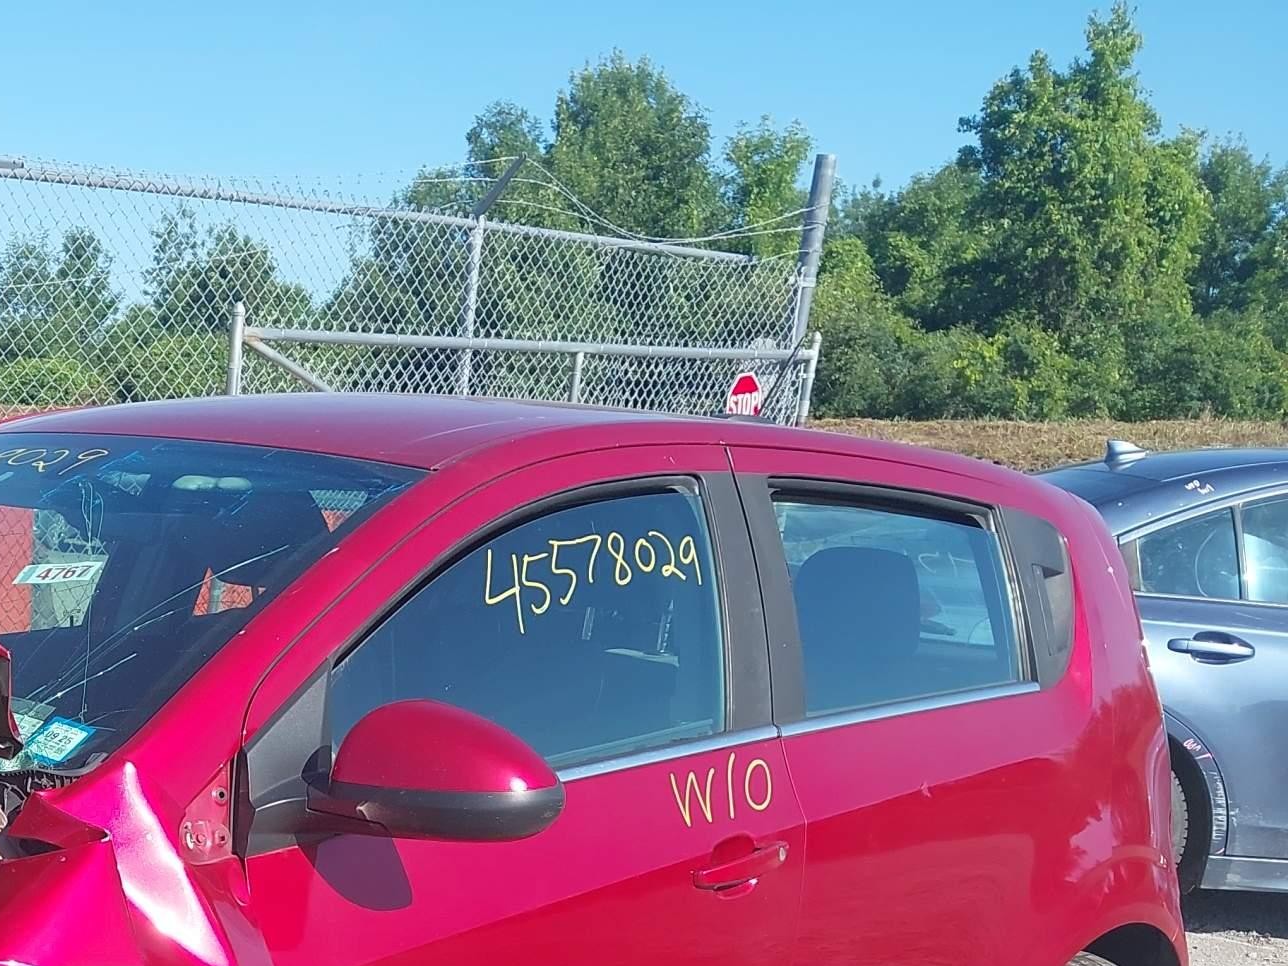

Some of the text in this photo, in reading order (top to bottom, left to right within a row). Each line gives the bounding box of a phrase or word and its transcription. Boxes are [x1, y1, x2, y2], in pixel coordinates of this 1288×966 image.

[729, 392, 761, 415] STOP
[35, 564, 94, 581] 4767
[485, 531, 703, 634] 45578029
